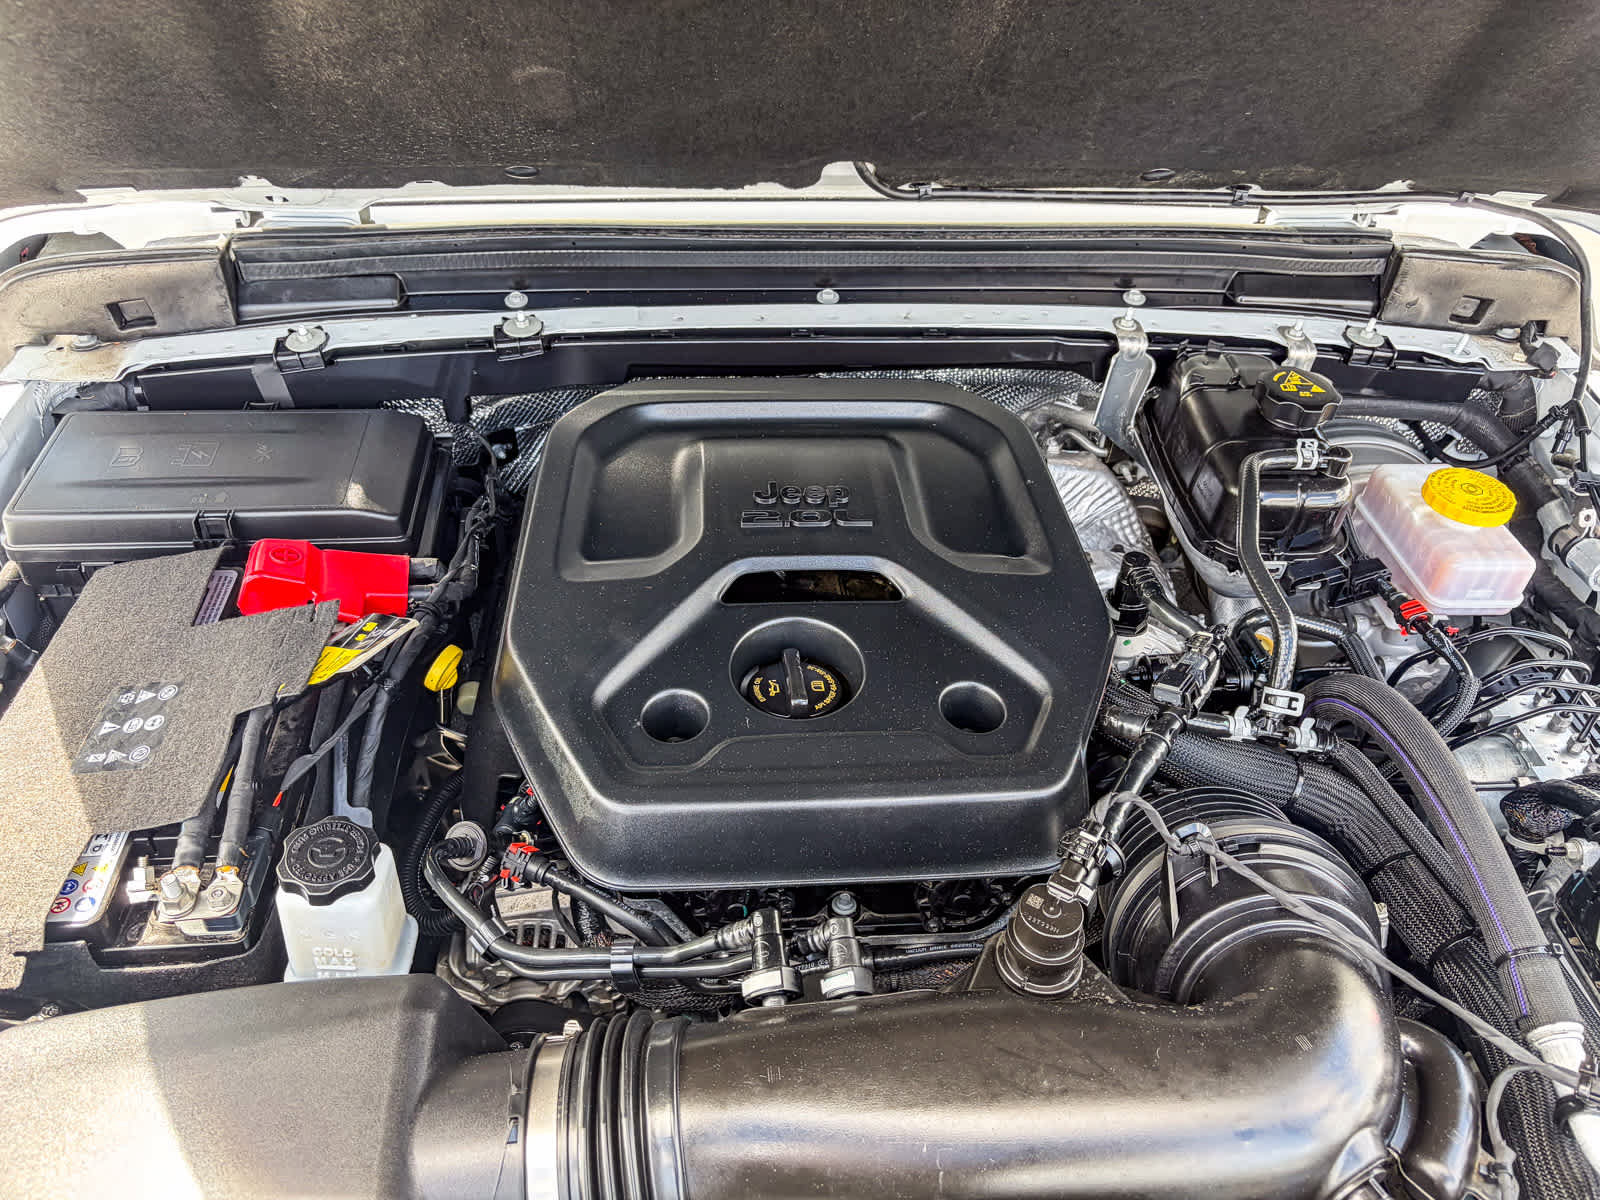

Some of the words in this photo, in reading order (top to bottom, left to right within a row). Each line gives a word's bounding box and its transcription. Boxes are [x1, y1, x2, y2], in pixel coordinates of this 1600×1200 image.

[753, 480, 850, 507] Jeep
[740, 509, 873, 528] 2.0L
[312, 946, 354, 958] COLD
[314, 956, 356, 967] MAX
